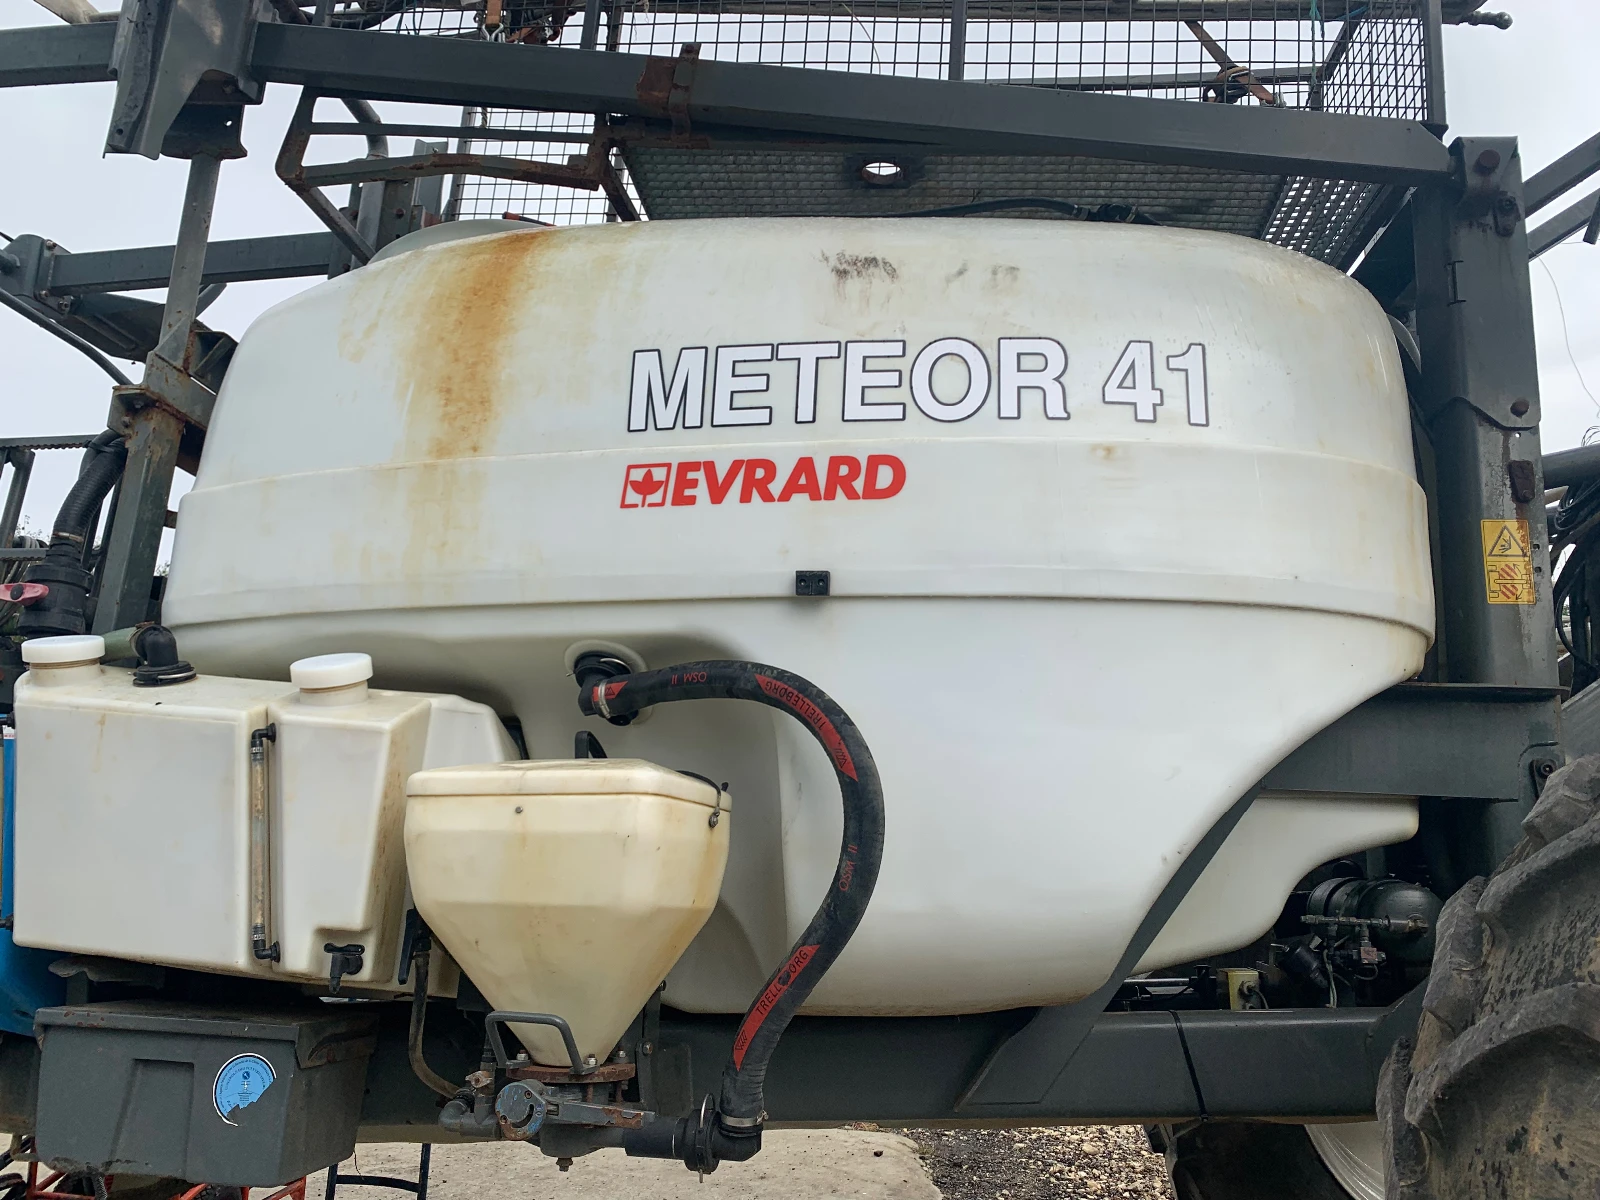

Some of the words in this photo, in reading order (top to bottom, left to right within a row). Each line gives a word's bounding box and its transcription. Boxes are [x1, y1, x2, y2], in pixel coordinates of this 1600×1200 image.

[627, 337, 1071, 432] METEOR
[1102, 340, 1210, 427] 41
[670, 454, 907, 507] EVRARD
[765, 680, 827, 731] TRELLEBORG
[756, 949, 809, 1016] TRELLORG
